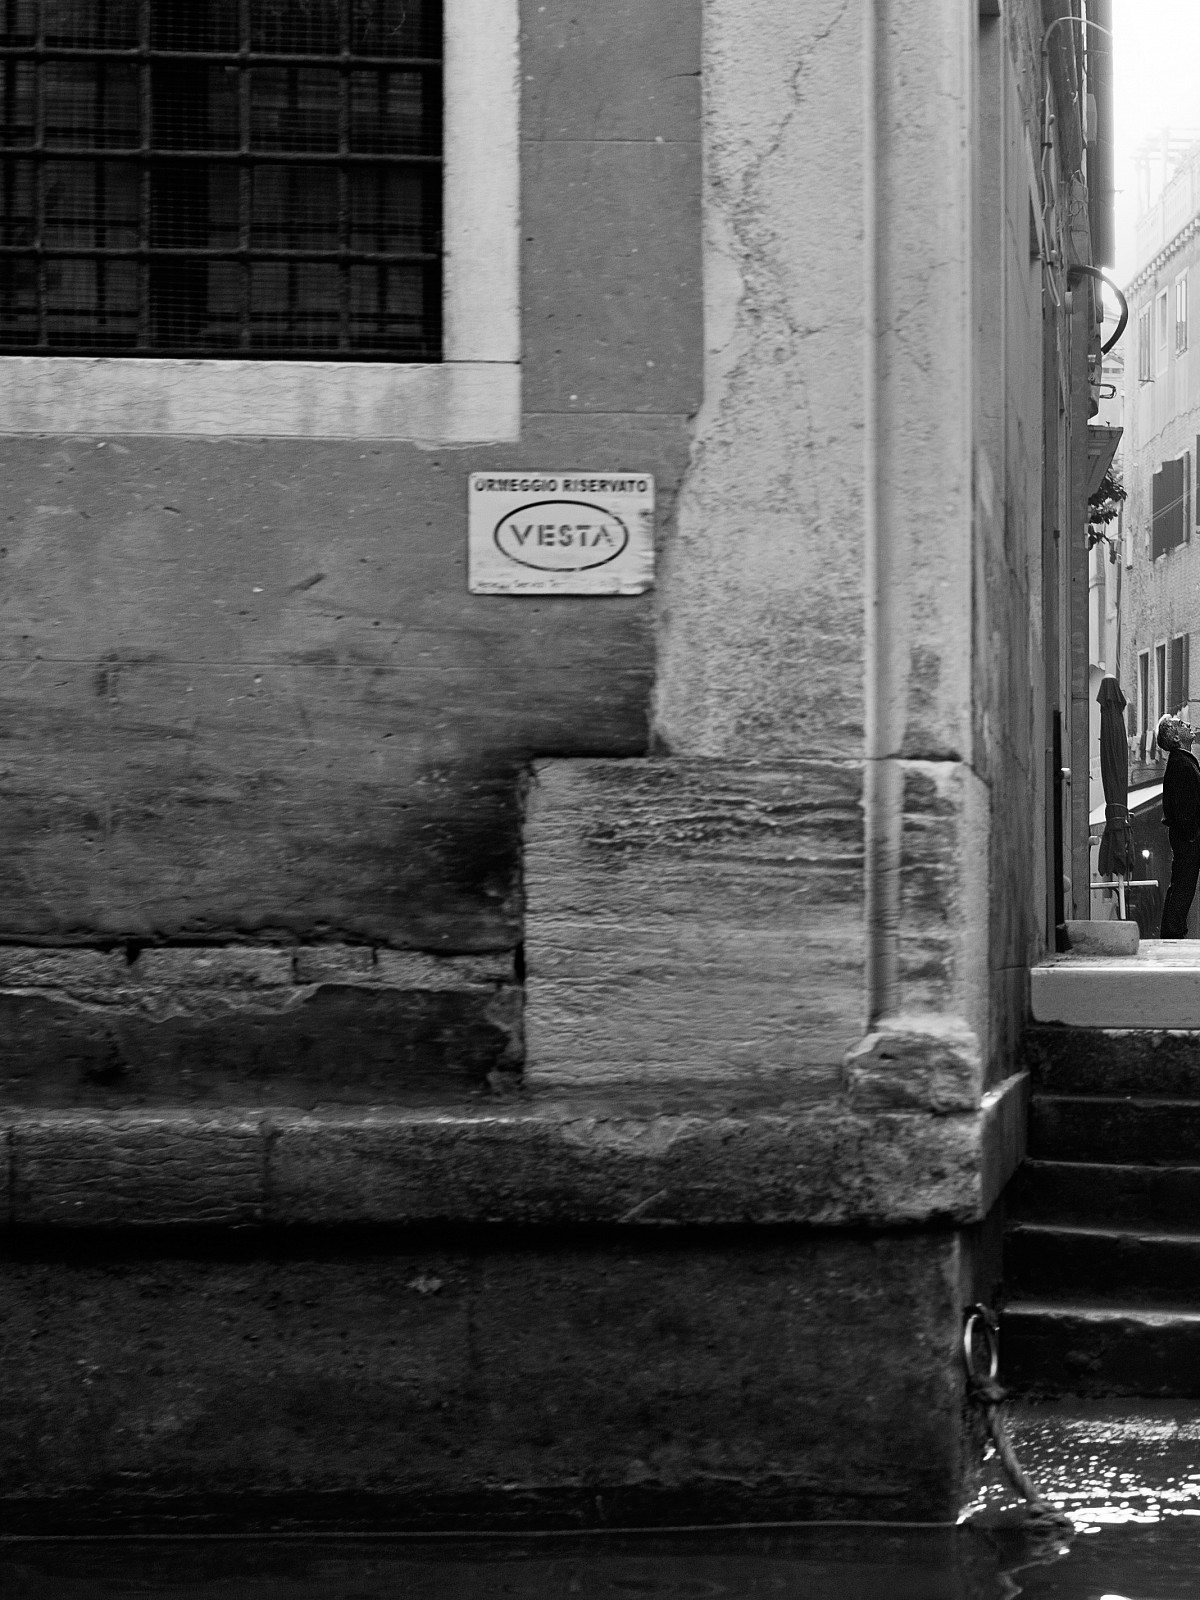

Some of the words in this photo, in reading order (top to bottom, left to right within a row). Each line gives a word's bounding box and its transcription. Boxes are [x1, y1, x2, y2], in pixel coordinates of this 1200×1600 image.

[474, 478, 559, 492] ORMEGGIO
[562, 479, 648, 493] RISERVATO
[509, 524, 616, 547] VESTA
